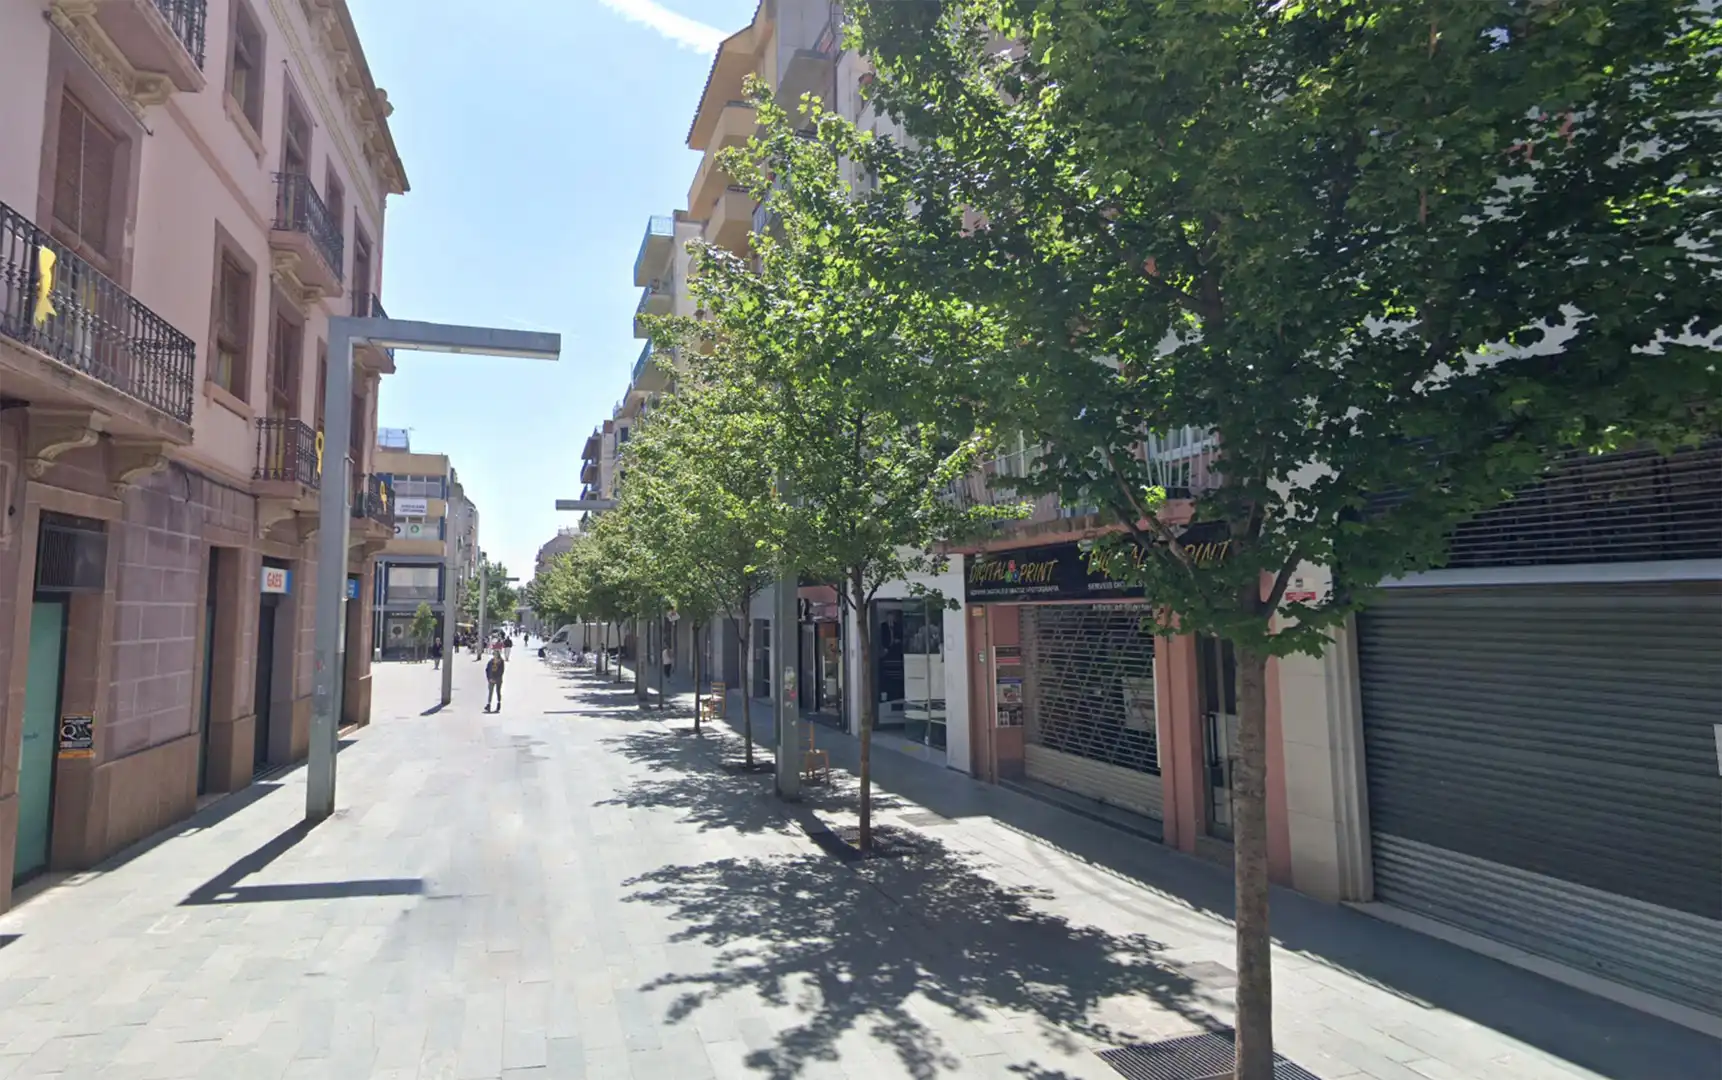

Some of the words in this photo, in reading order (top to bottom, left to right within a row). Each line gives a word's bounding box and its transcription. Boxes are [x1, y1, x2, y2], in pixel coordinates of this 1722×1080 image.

[267, 571, 283, 588] GAES
[969, 560, 1006, 586] DIGITAL
[1019, 558, 1059, 584] PRINT
